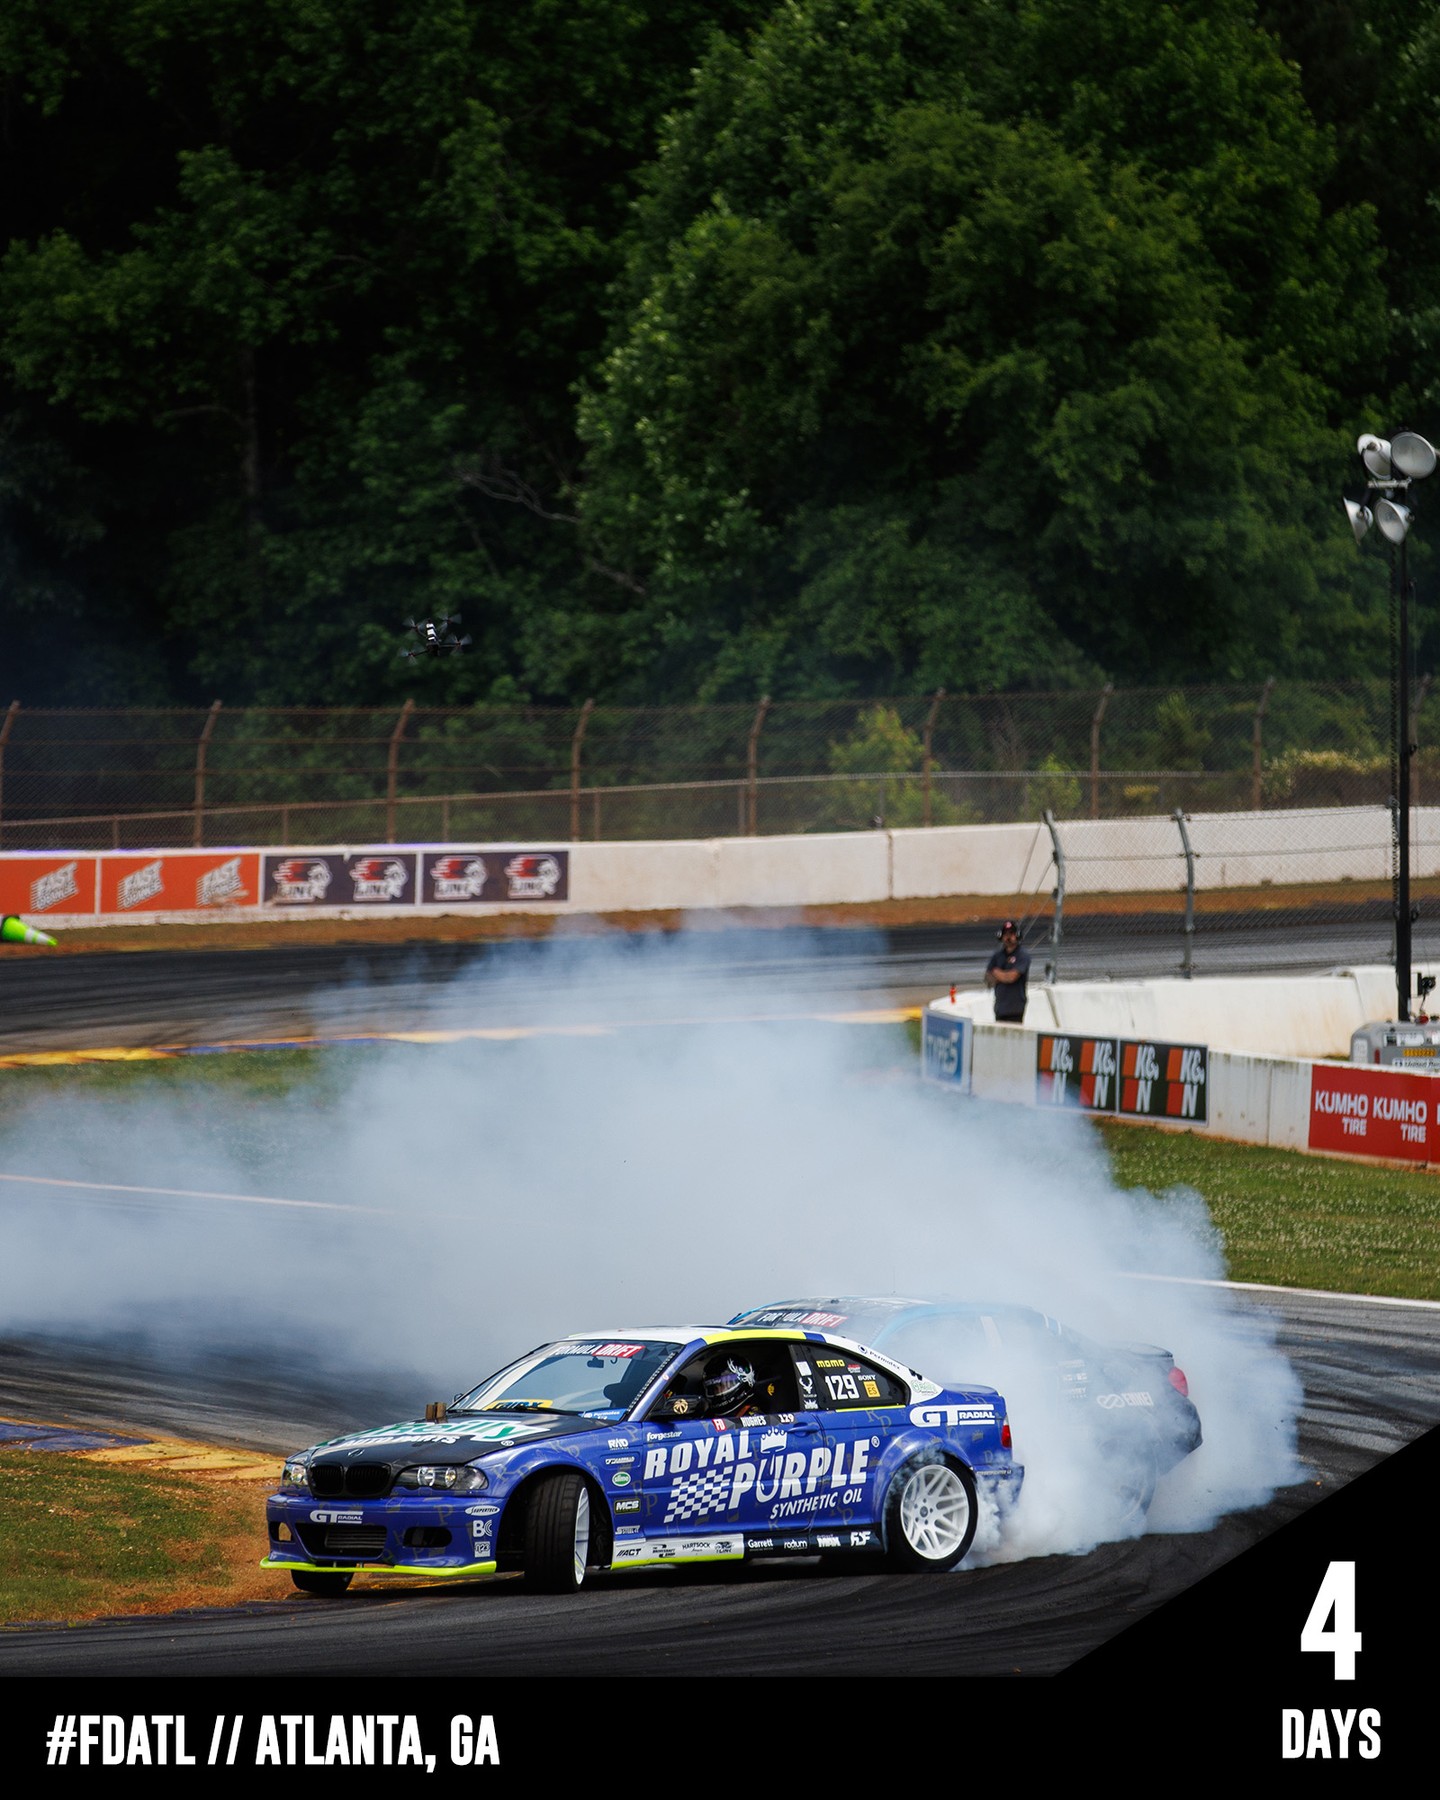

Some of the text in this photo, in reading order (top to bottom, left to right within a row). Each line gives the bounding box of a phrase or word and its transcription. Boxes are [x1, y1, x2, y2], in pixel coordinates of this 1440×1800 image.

[1314, 1090, 1368, 1118] KUMHO
[1372, 1096, 1427, 1124] KUMHO
[1342, 1116, 1367, 1136] TIRE
[1400, 1123, 1427, 1143] TIRE
[596, 1343, 641, 1358] DRIFT
[825, 1375, 860, 1400] 129
[740, 1415, 767, 1427] HUGHES
[778, 1413, 794, 1423] 129
[909, 1404, 995, 1428] GT RADIAL
[646, 1431, 683, 1442] forgestar
[643, 1430, 753, 1480] ROYAL
[728, 1438, 871, 1511] PURPLE
[616, 1500, 640, 1511] MCS
[770, 1488, 863, 1520] SYNTHETIC OIL
[747, 1538, 774, 1549] Garrett
